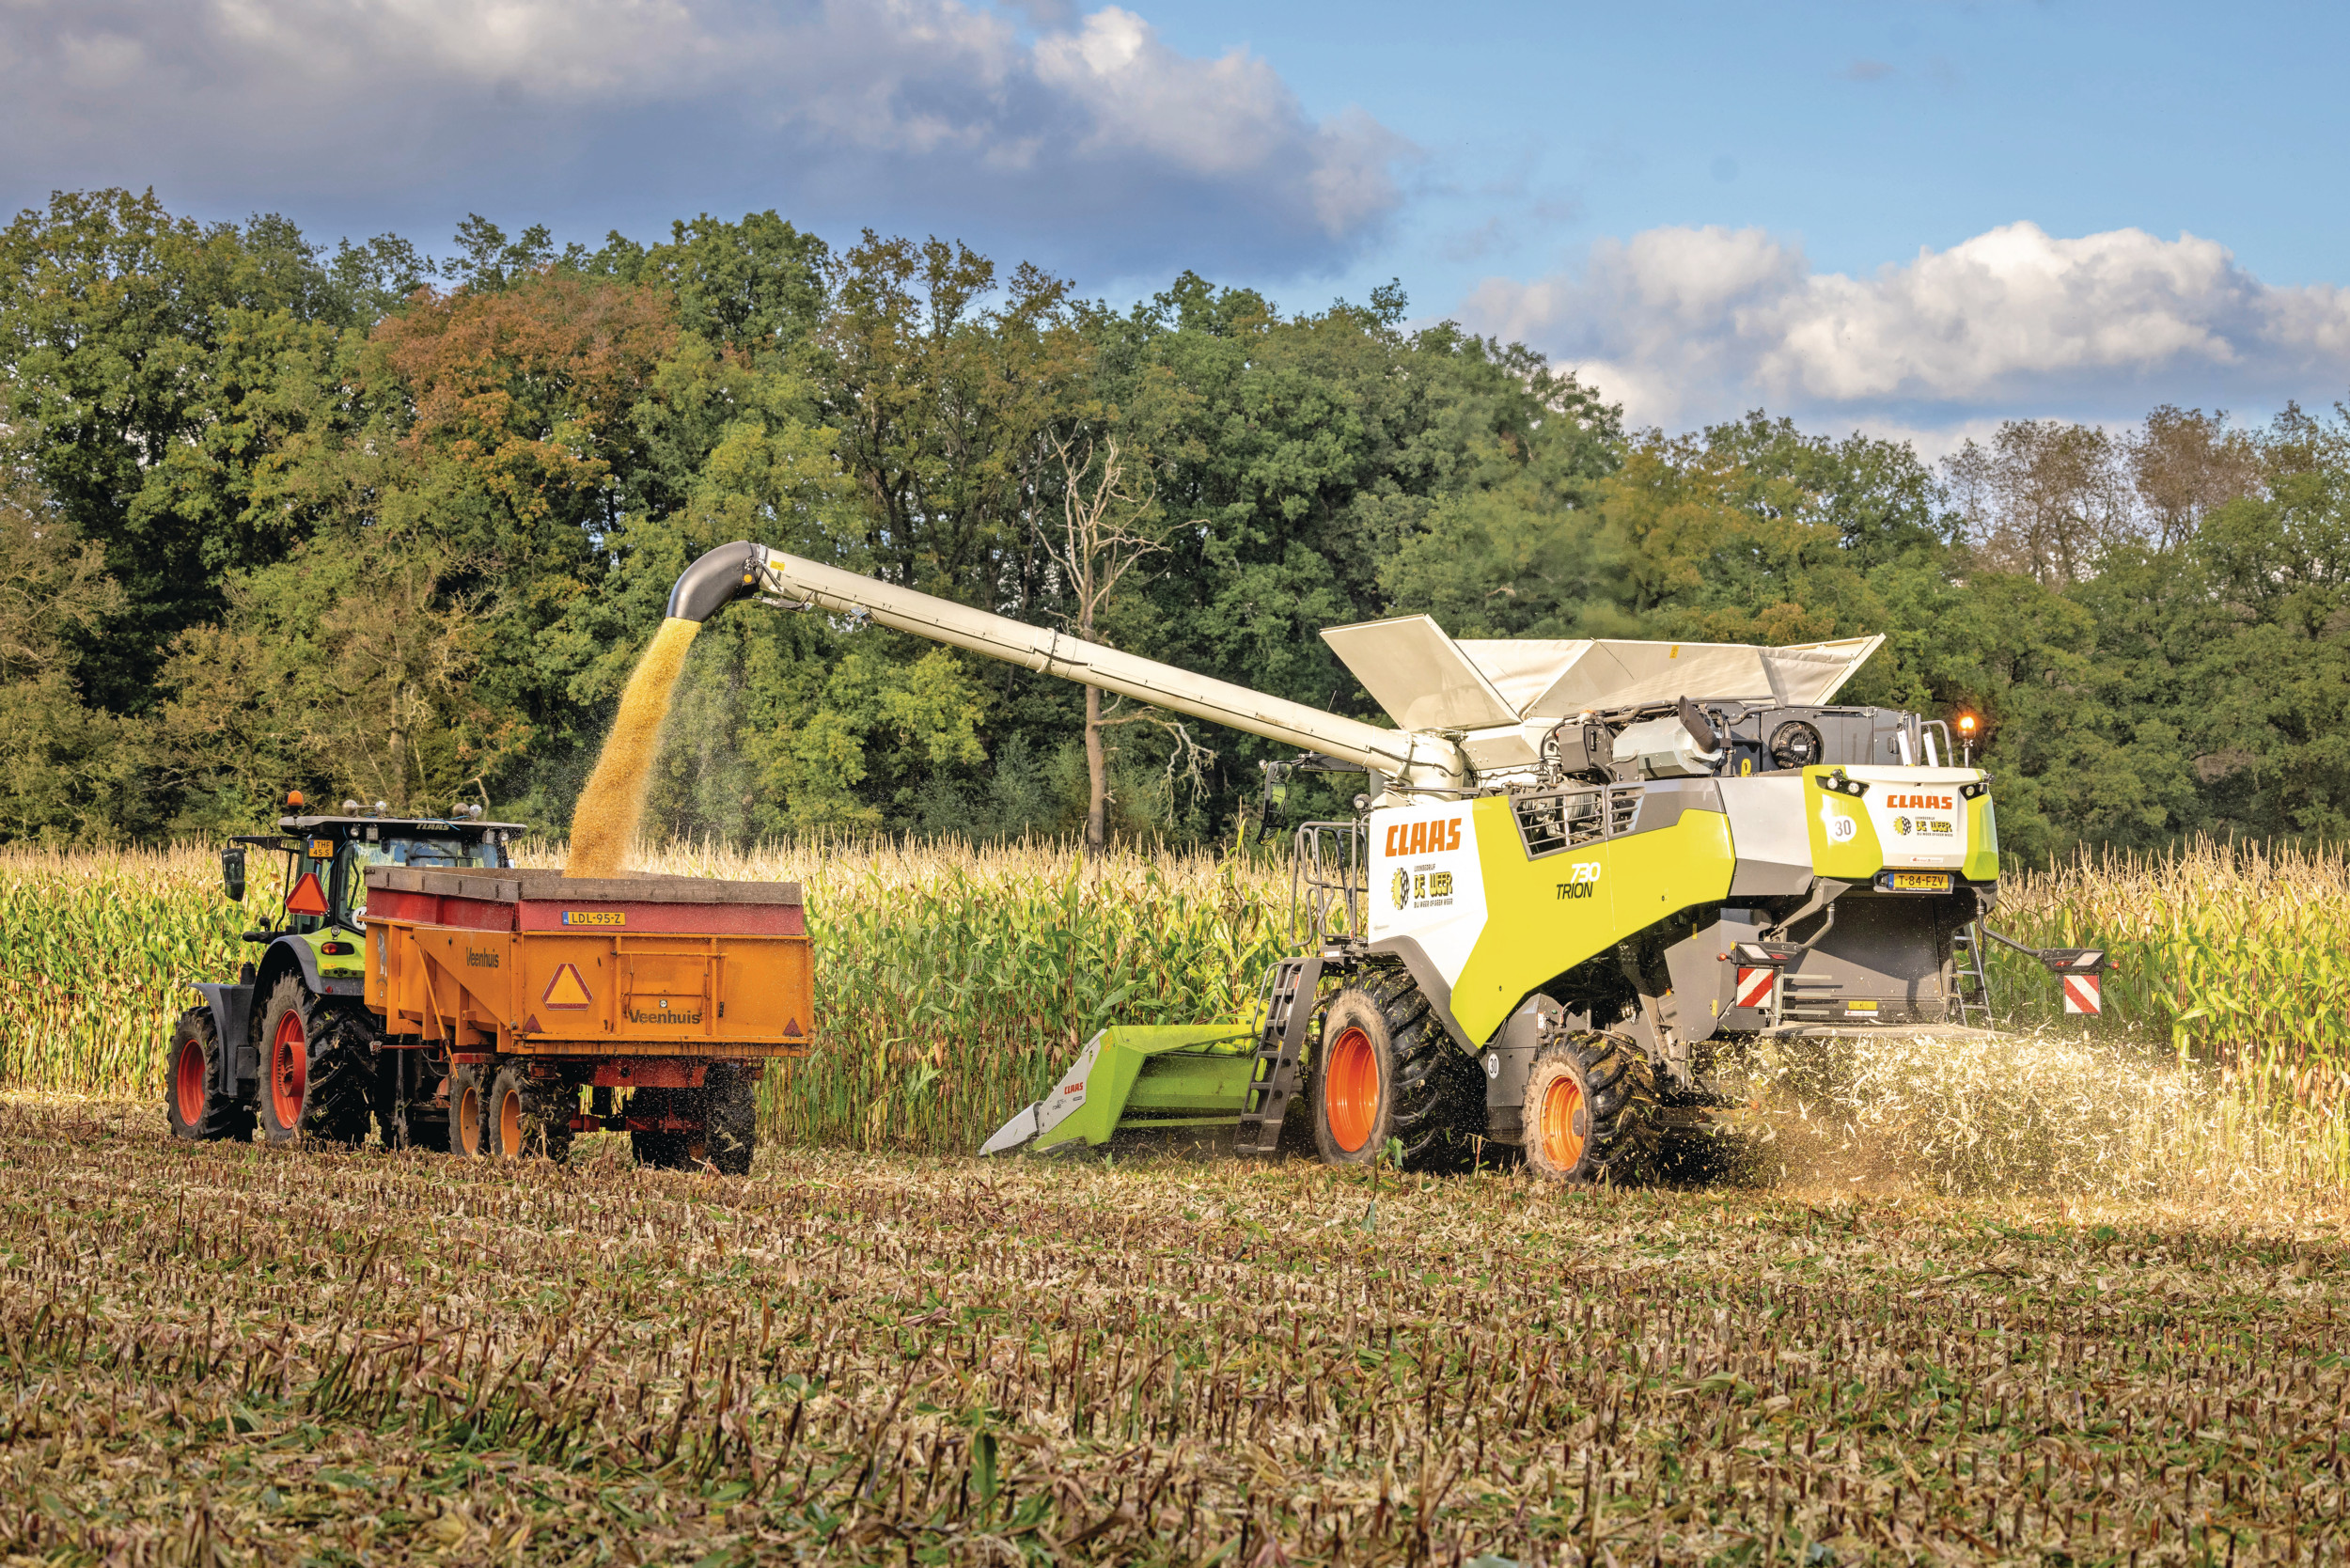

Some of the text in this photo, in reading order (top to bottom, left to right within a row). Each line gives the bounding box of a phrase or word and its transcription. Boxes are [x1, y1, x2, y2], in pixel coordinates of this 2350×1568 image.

[1887, 795, 1952, 809] CLAAS
[1835, 820, 1852, 837] 30
[1916, 821, 1952, 833] DE WEER
[1386, 818, 1462, 857] CLAAS
[1570, 862, 1601, 884] 730
[1899, 875, 1944, 886] T-84-FZV
[1414, 871, 1453, 899] DE WEER
[1557, 882, 1593, 900] TRION
[572, 914, 620, 923] LDL-95-Z
[466, 947, 499, 968] Veenhuis
[628, 1010, 700, 1024] Veenhuis
[1490, 1058, 1497, 1074] 30
[1064, 1082, 1084, 1095] CLAAS
